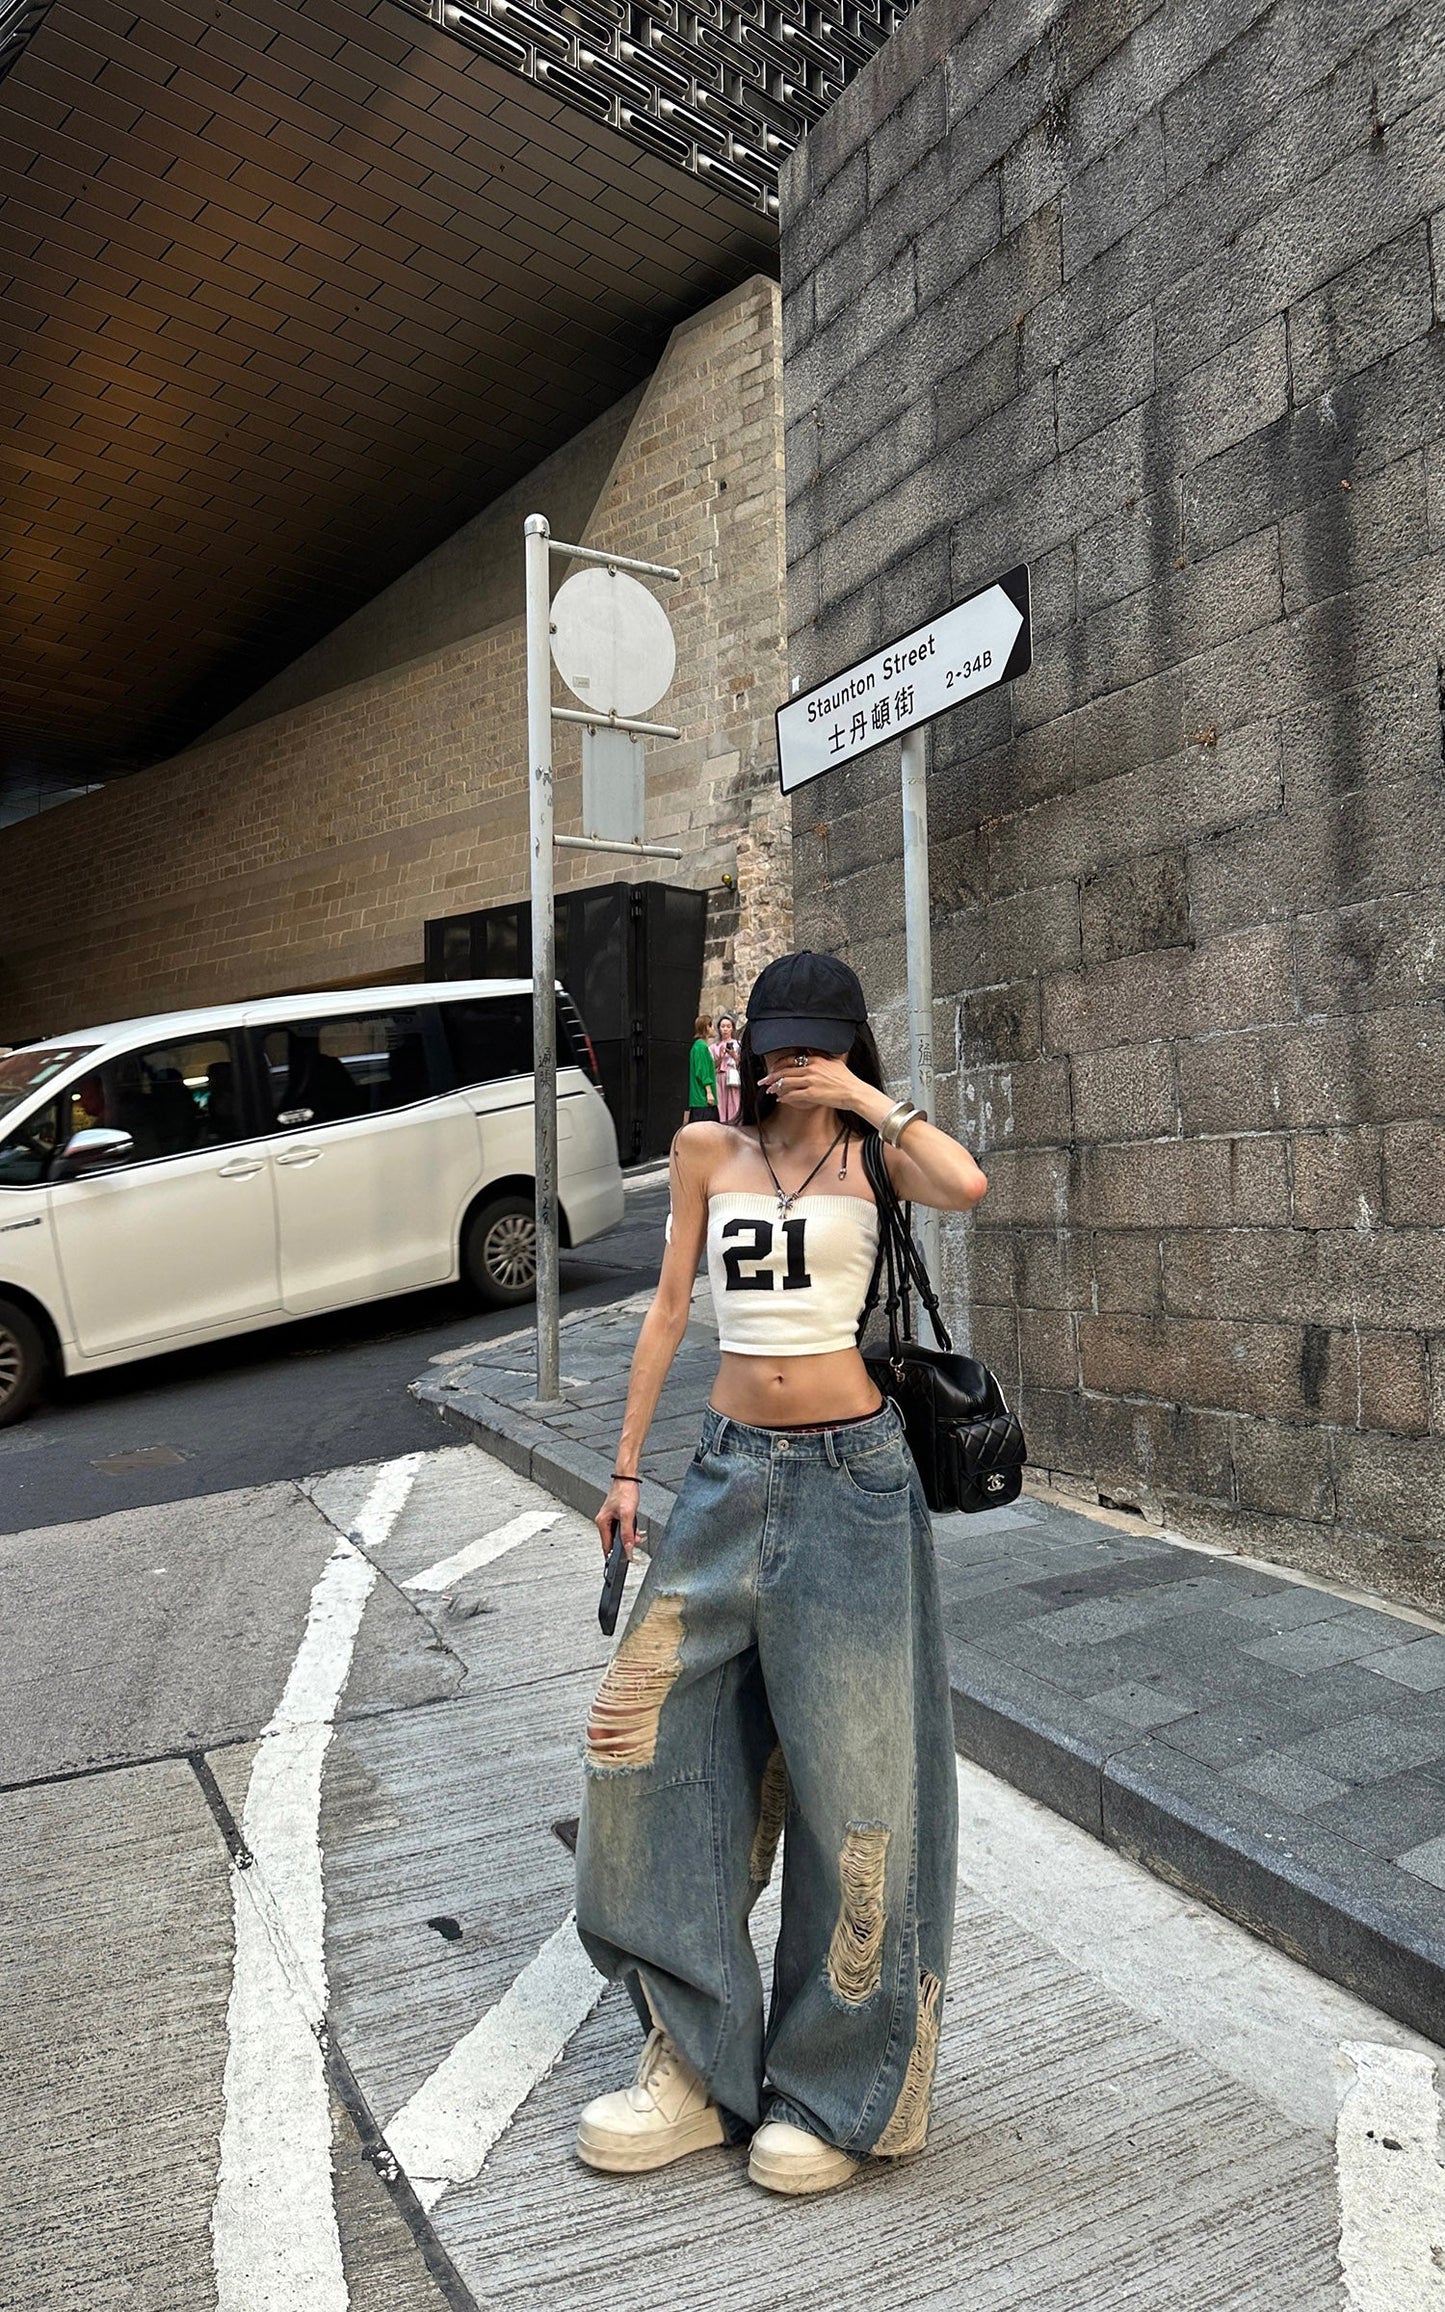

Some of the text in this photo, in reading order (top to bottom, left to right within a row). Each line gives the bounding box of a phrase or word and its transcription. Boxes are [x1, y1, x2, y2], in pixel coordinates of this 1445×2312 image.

[807, 634, 936, 723] Staunton Street
[945, 650, 993, 689] 2-34B
[828, 684, 915, 755] 士丹頓街
[722, 1218, 812, 1291] 21
